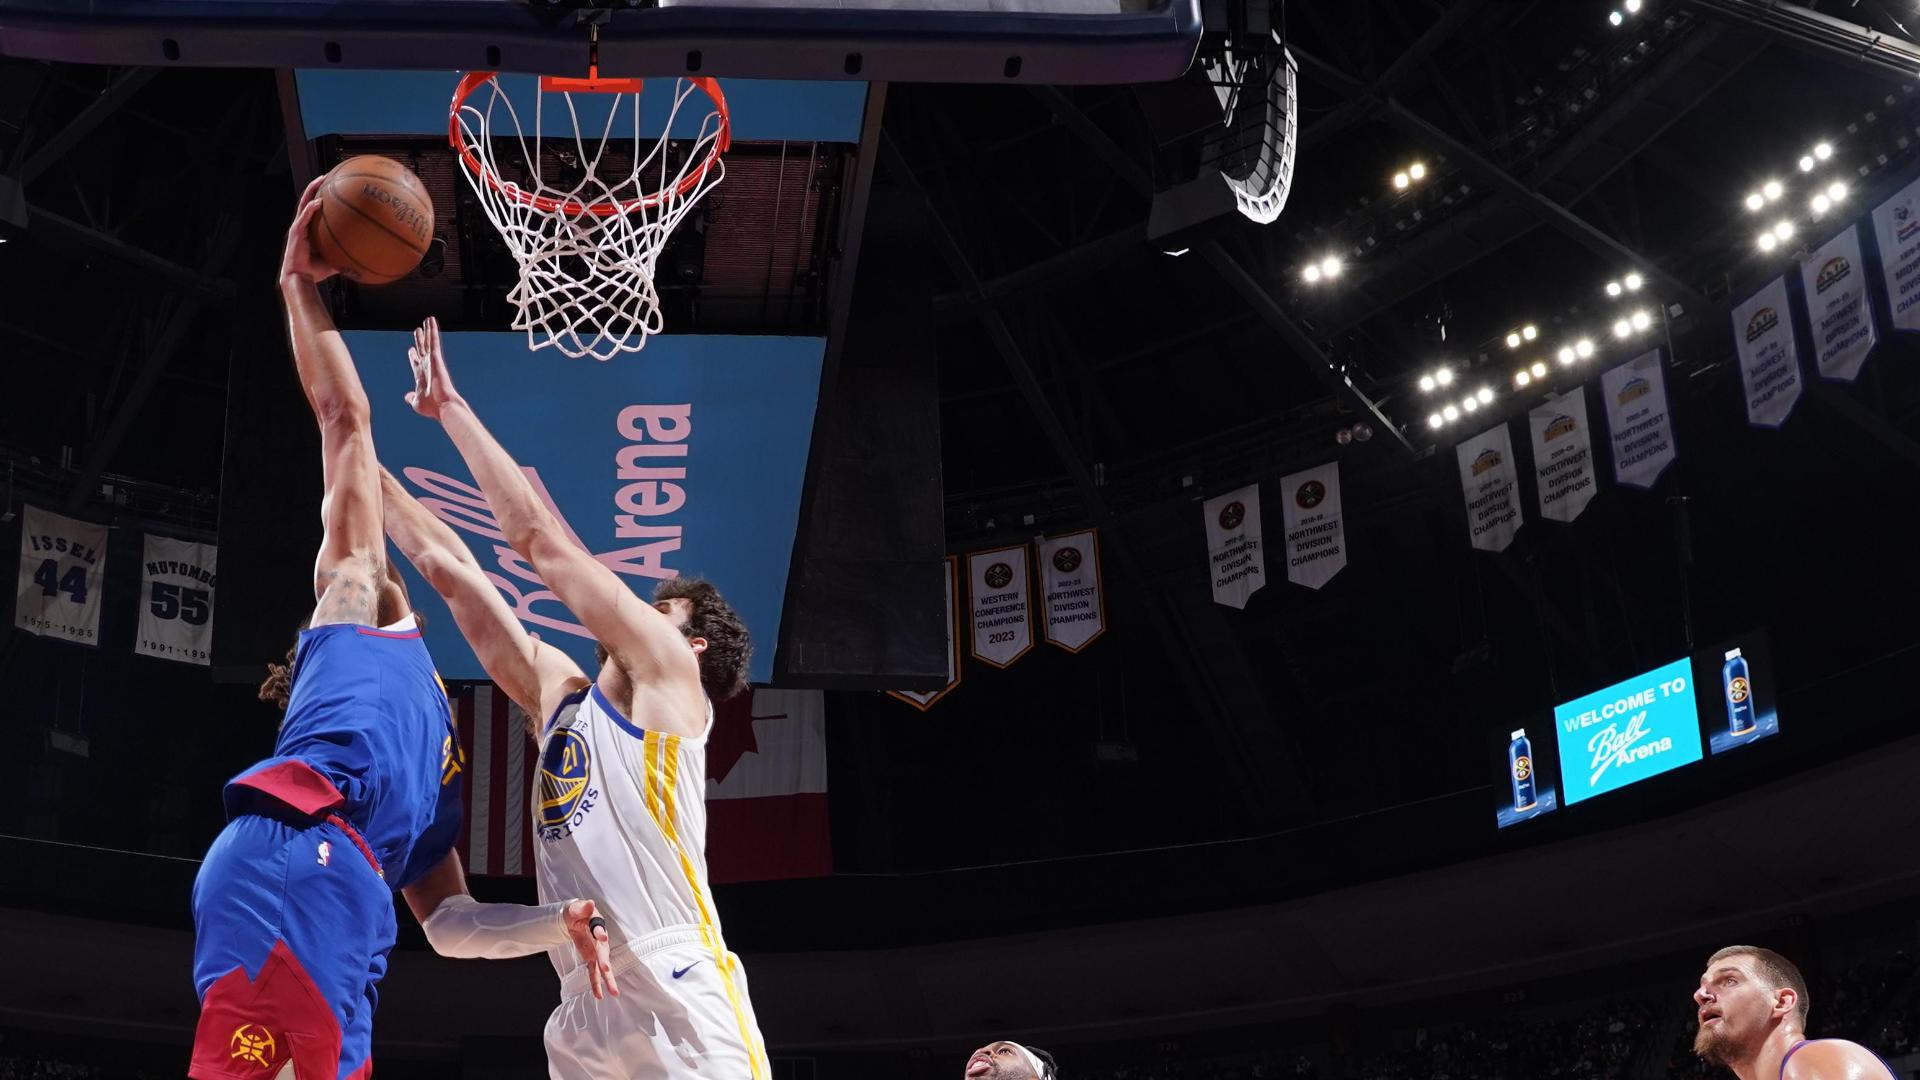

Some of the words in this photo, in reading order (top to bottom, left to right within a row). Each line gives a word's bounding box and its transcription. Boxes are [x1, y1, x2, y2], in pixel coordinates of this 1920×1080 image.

[1822, 325, 1869, 363] CHAMPIONS
[1751, 374, 1796, 410] CHAMPIONS
[1754, 365, 1788, 392] DIVISION
[1614, 413, 1664, 442] NORTHWEST
[1619, 441, 1668, 470] CHAMPIONS
[1624, 430, 1660, 454] DIVISION
[1539, 449, 1587, 479] NORTHWEST
[1548, 467, 1583, 488] DIVISION
[595, 403, 692, 580] Arena
[1543, 476, 1591, 505] CHAMPIONS
[1288, 520, 1339, 542] NORTHWEST
[1473, 507, 1517, 536] CHAMPIONS
[31, 535, 97, 565] ISSEL
[1213, 541, 1258, 563] NORTHWEST
[1291, 546, 1340, 567] CHAMPIONS
[1296, 535, 1333, 552] DIVISION
[34, 558, 88, 605] 44
[1047, 587, 1095, 602] NORTHWEST
[150, 581, 210, 626] 55
[975, 602, 1025, 618] CONFERENCE
[981, 592, 1019, 605] WESTERN
[1054, 600, 1089, 612] DIVISION
[977, 615, 1024, 629] CHAMPIONS
[1049, 611, 1097, 626] CHAMPIONS
[143, 640, 213, 660] 1991-199
[989, 630, 1015, 644] 2023
[1563, 688, 1656, 733] WELCOME
[1659, 677, 1687, 698] TO
[562, 741, 579, 776] 21
[1587, 710, 1651, 785] Ball
[1615, 736, 1673, 768] Arena
